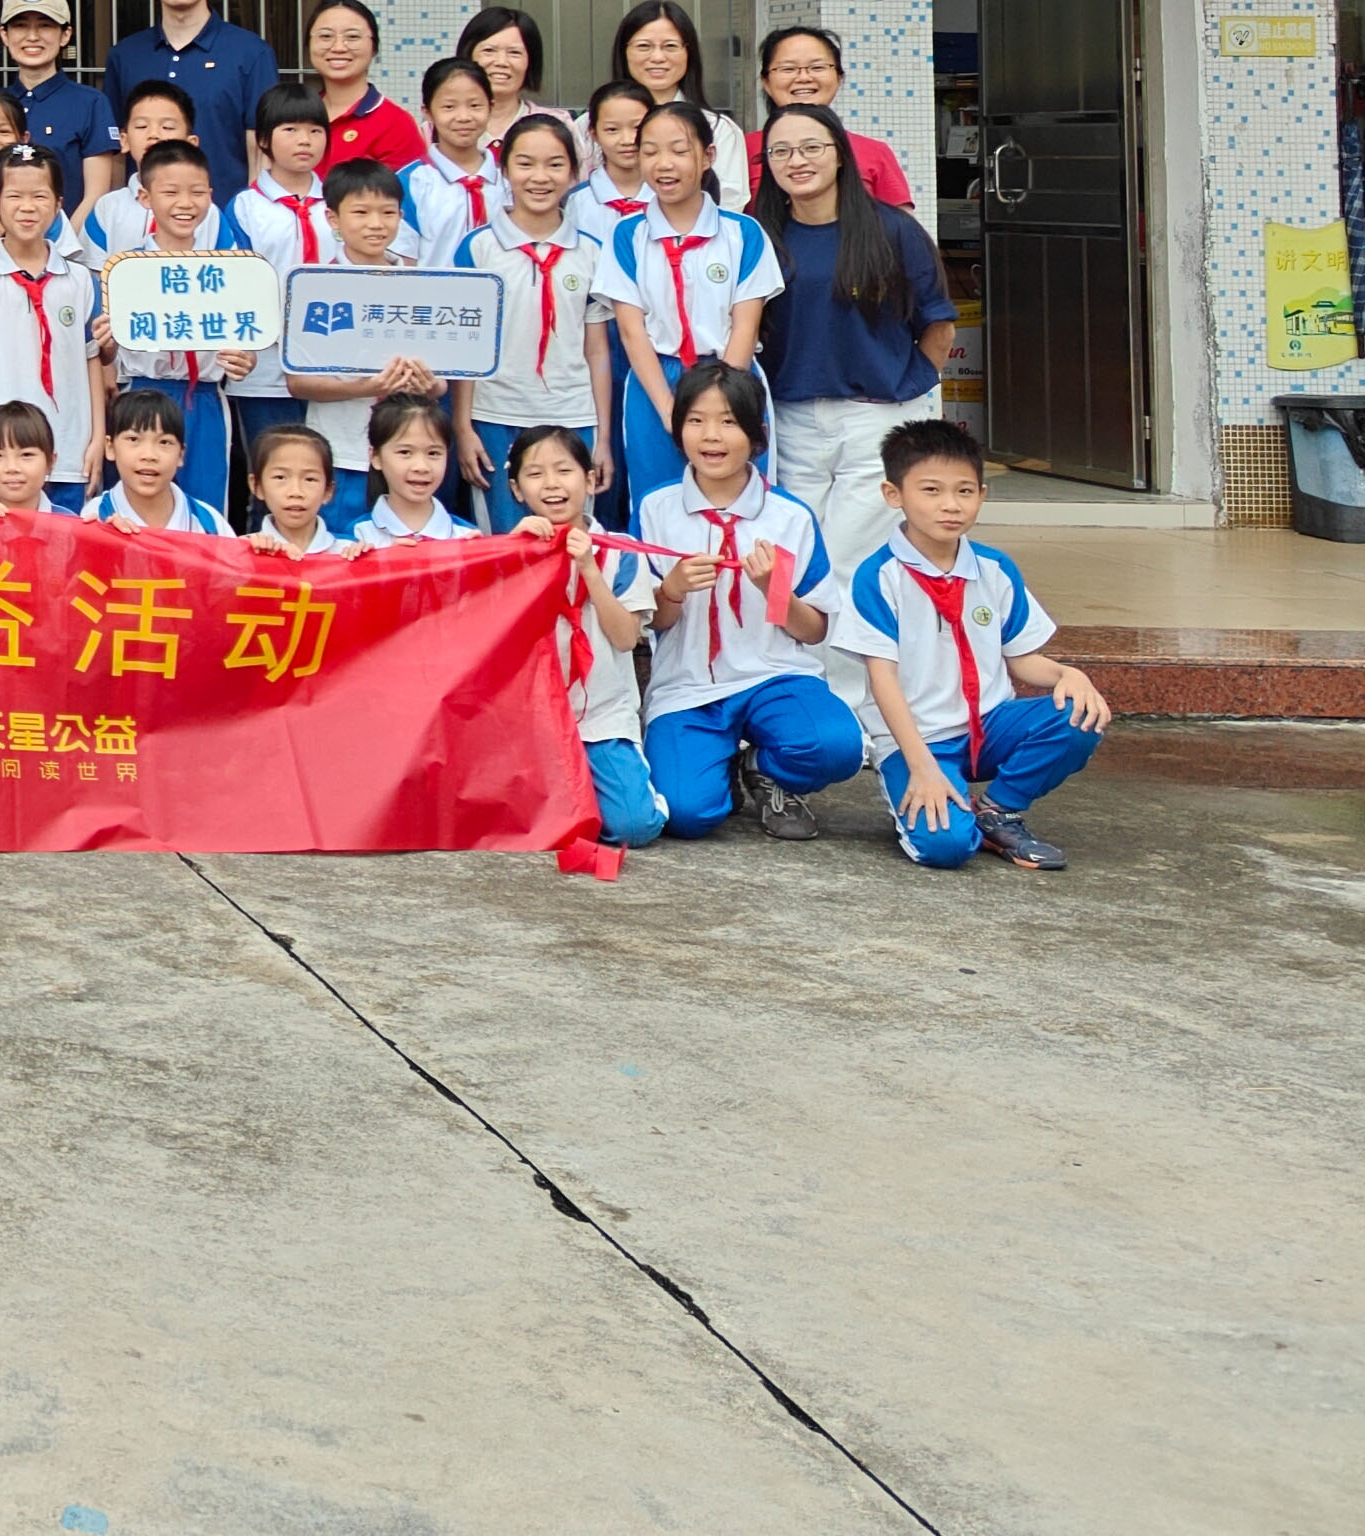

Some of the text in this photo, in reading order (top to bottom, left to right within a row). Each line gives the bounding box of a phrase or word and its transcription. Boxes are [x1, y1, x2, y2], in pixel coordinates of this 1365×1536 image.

[1276, 250, 1348, 271] 讲文明
[160, 264, 226, 294] 陪你
[129, 311, 262, 342] 阅读世界
[361, 304, 482, 328] 满天星公益
